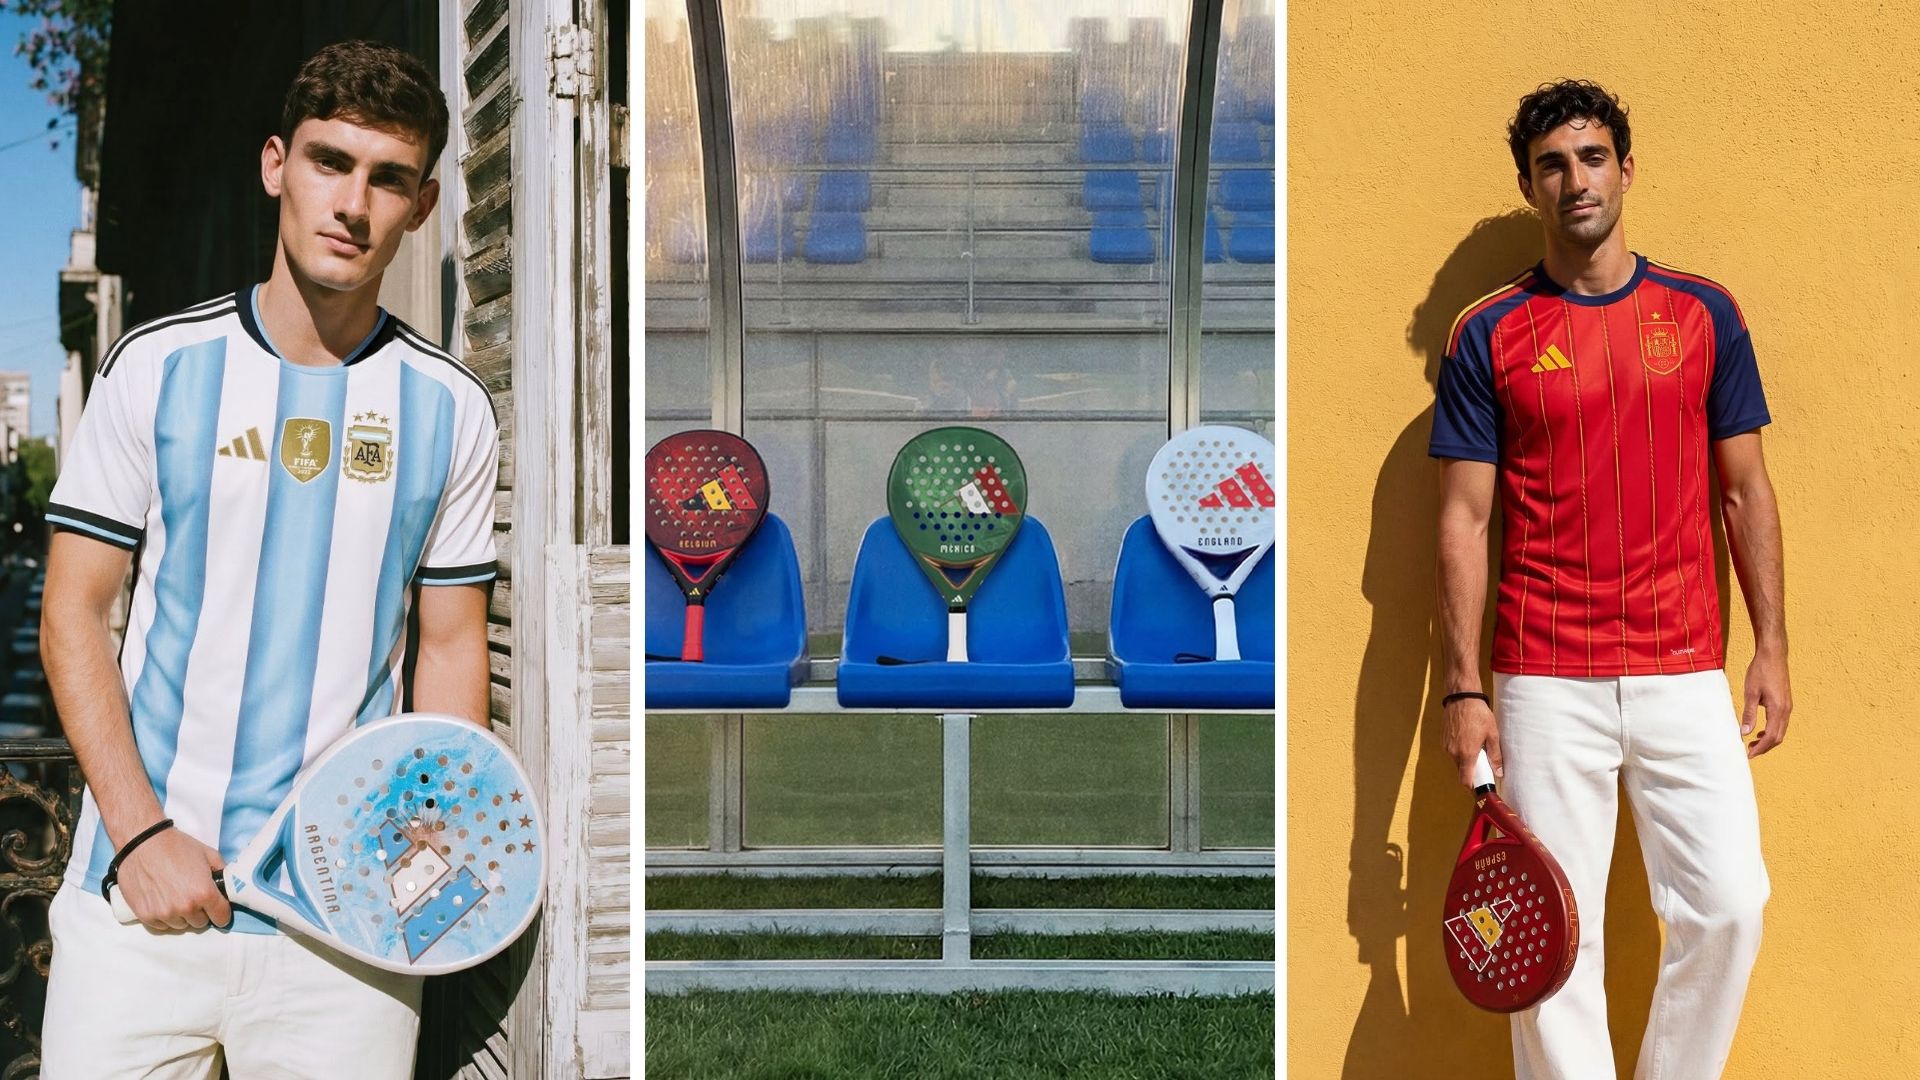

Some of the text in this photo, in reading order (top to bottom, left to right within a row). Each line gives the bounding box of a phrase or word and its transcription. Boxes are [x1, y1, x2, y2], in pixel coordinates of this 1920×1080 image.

[354, 440, 382, 467] AFA
[294, 458, 316, 467] FIFA
[679, 540, 717, 548] BELGIUM
[1198, 537, 1243, 546] ENGLAND
[1474, 851, 1507, 870] ESPAÑA
[305, 824, 340, 913] ARGENTINA
